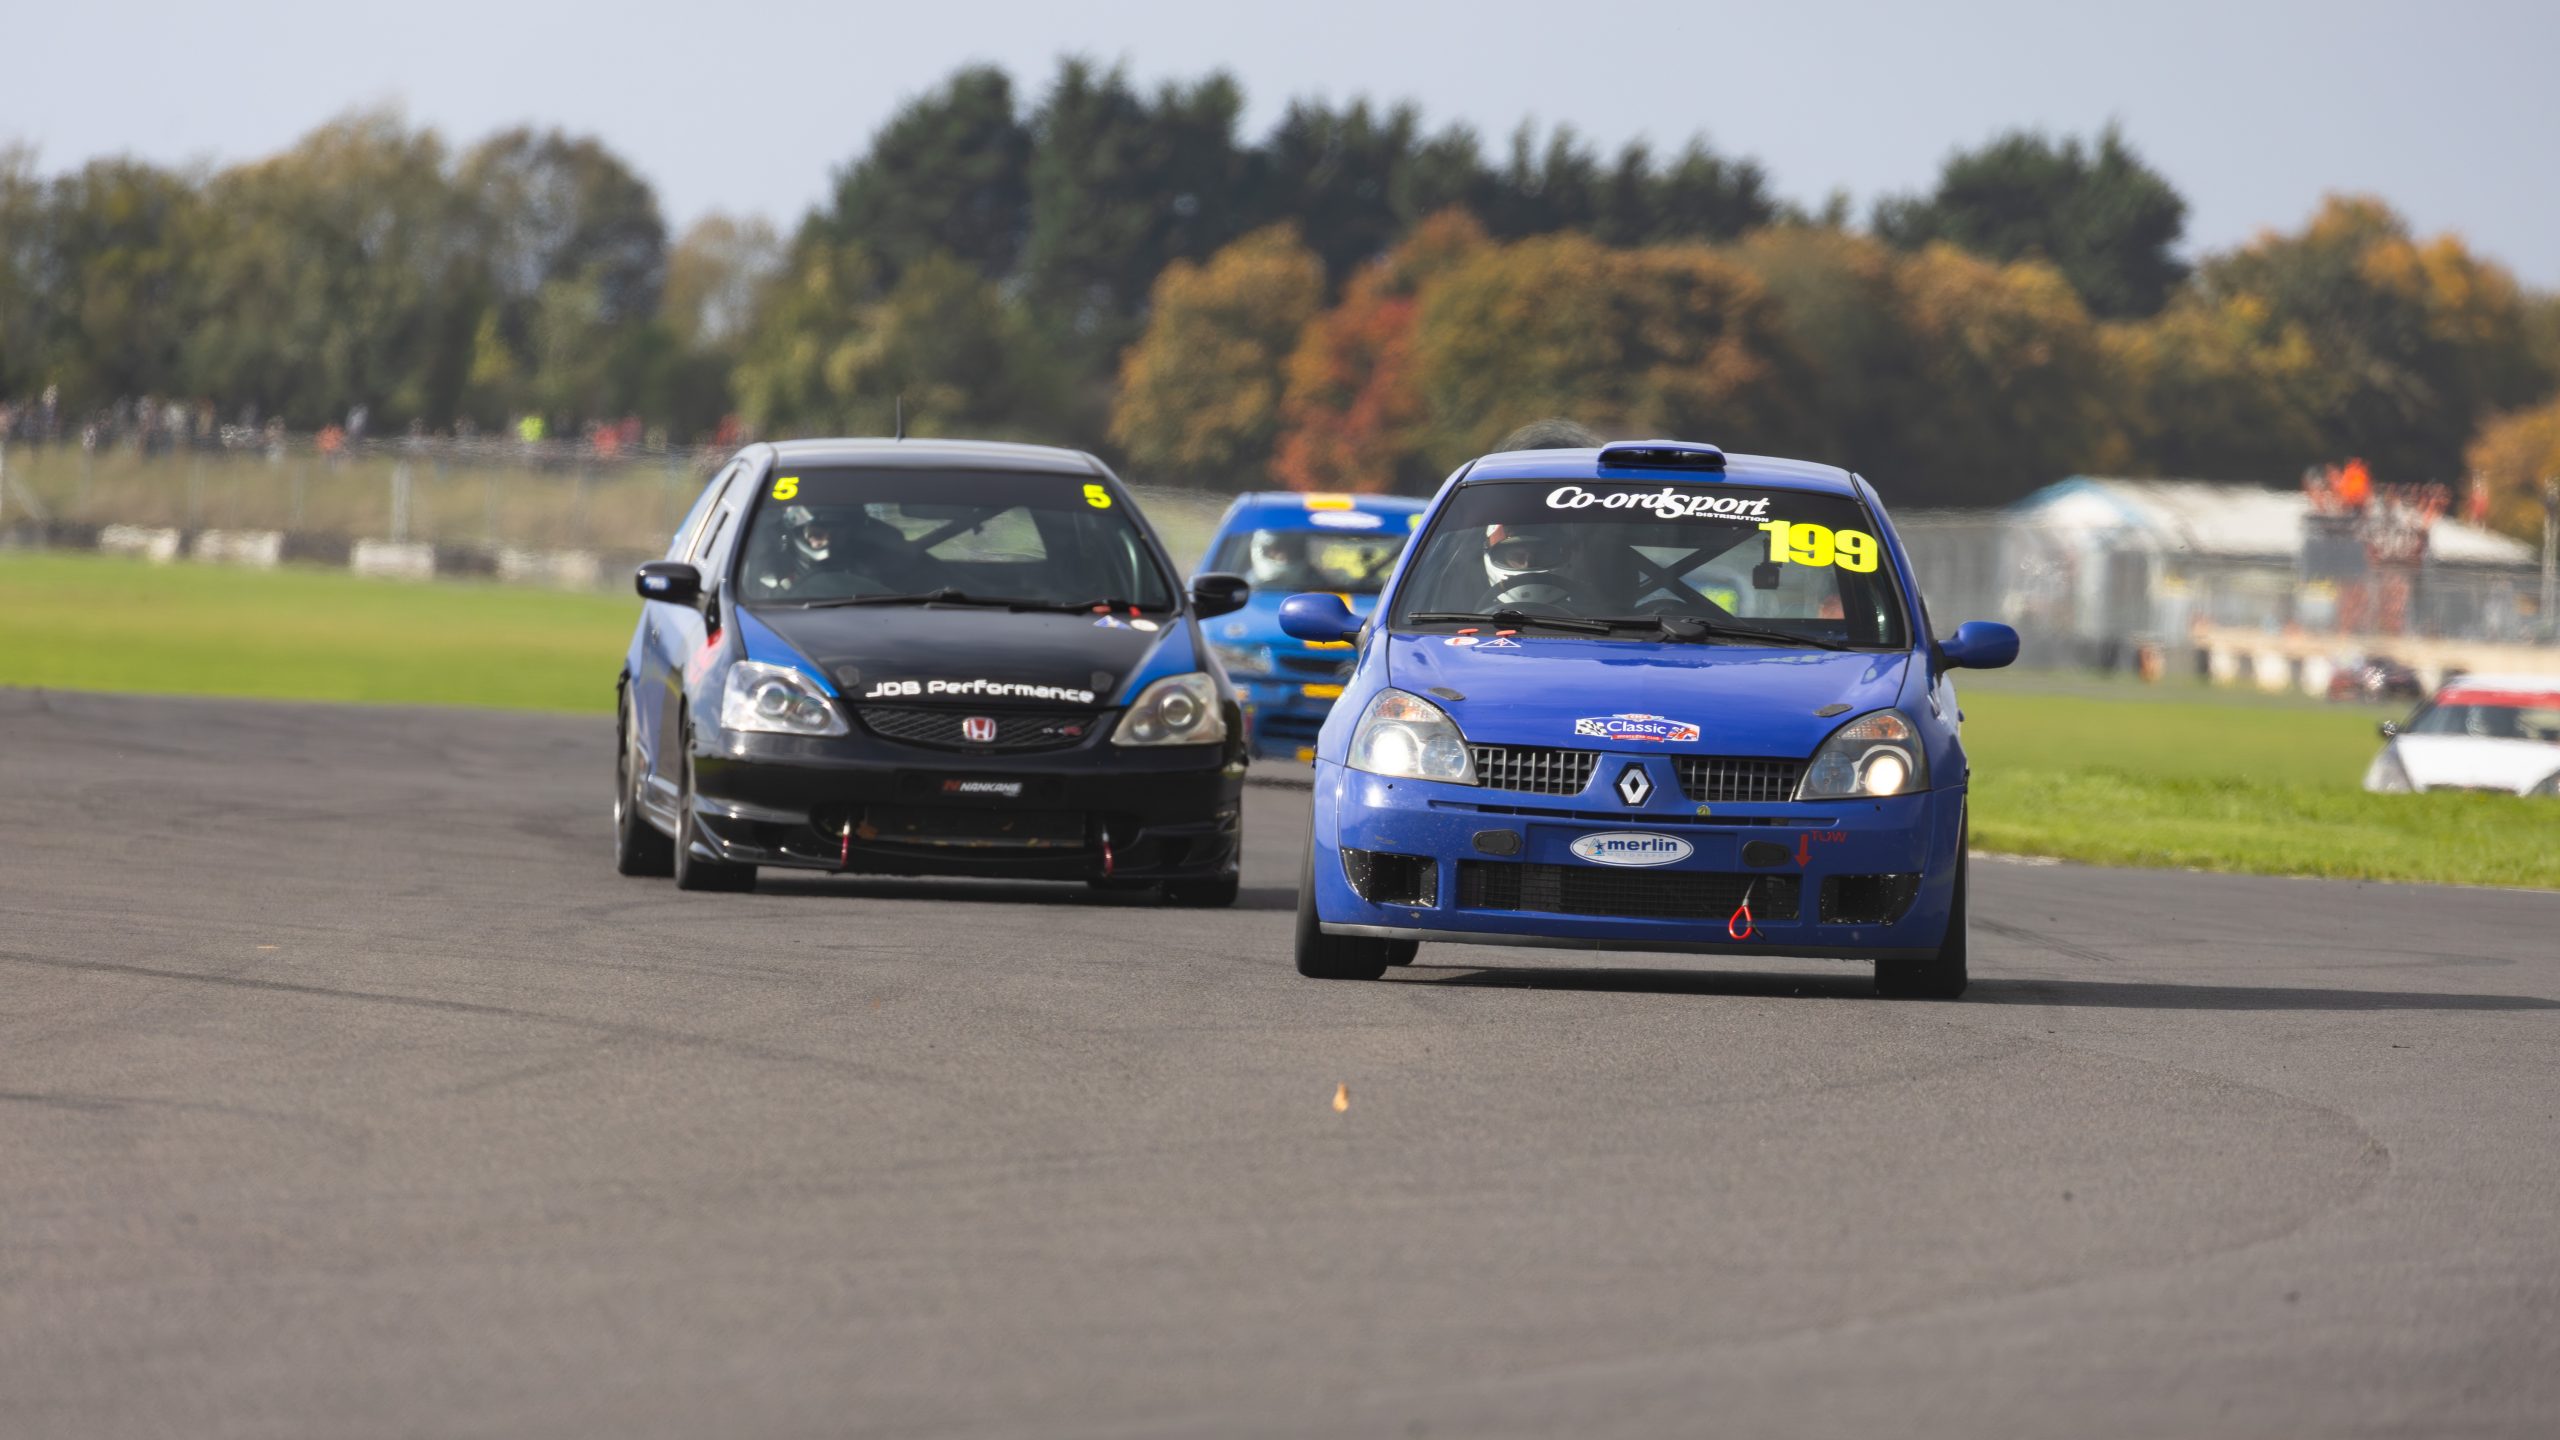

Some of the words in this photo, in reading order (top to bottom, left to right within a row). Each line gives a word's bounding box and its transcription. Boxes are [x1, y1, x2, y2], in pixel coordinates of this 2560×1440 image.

[772, 477, 799, 500] 5
[1083, 484, 1112, 509] 5
[1695, 511, 1770, 523] DISTRIBUTION
[1758, 519, 1878, 574] 199
[865, 681, 921, 698] JDB
[927, 679, 1095, 704] Performance
[1606, 720, 1667, 735] Classic
[1607, 838, 1678, 852] merlin
[1809, 829, 1847, 844] TOW
